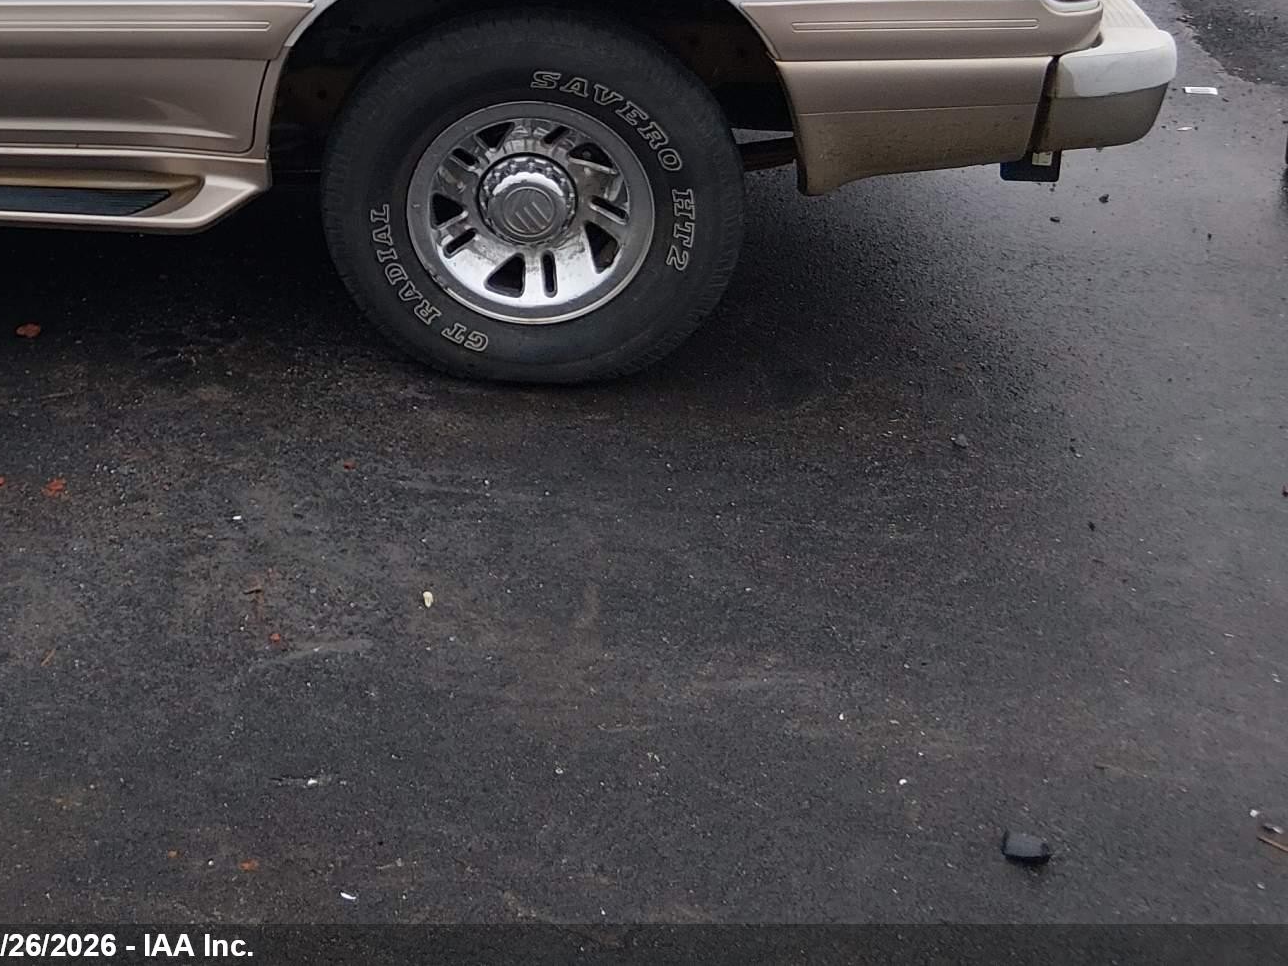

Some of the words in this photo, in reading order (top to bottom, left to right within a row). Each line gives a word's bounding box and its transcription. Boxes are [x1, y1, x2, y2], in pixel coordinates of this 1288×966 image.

[530, 70, 683, 173] SAVERO
[666, 188, 695, 272] HT2
[368, 203, 443, 329] RADIAL
[442, 325, 489, 353] GT
